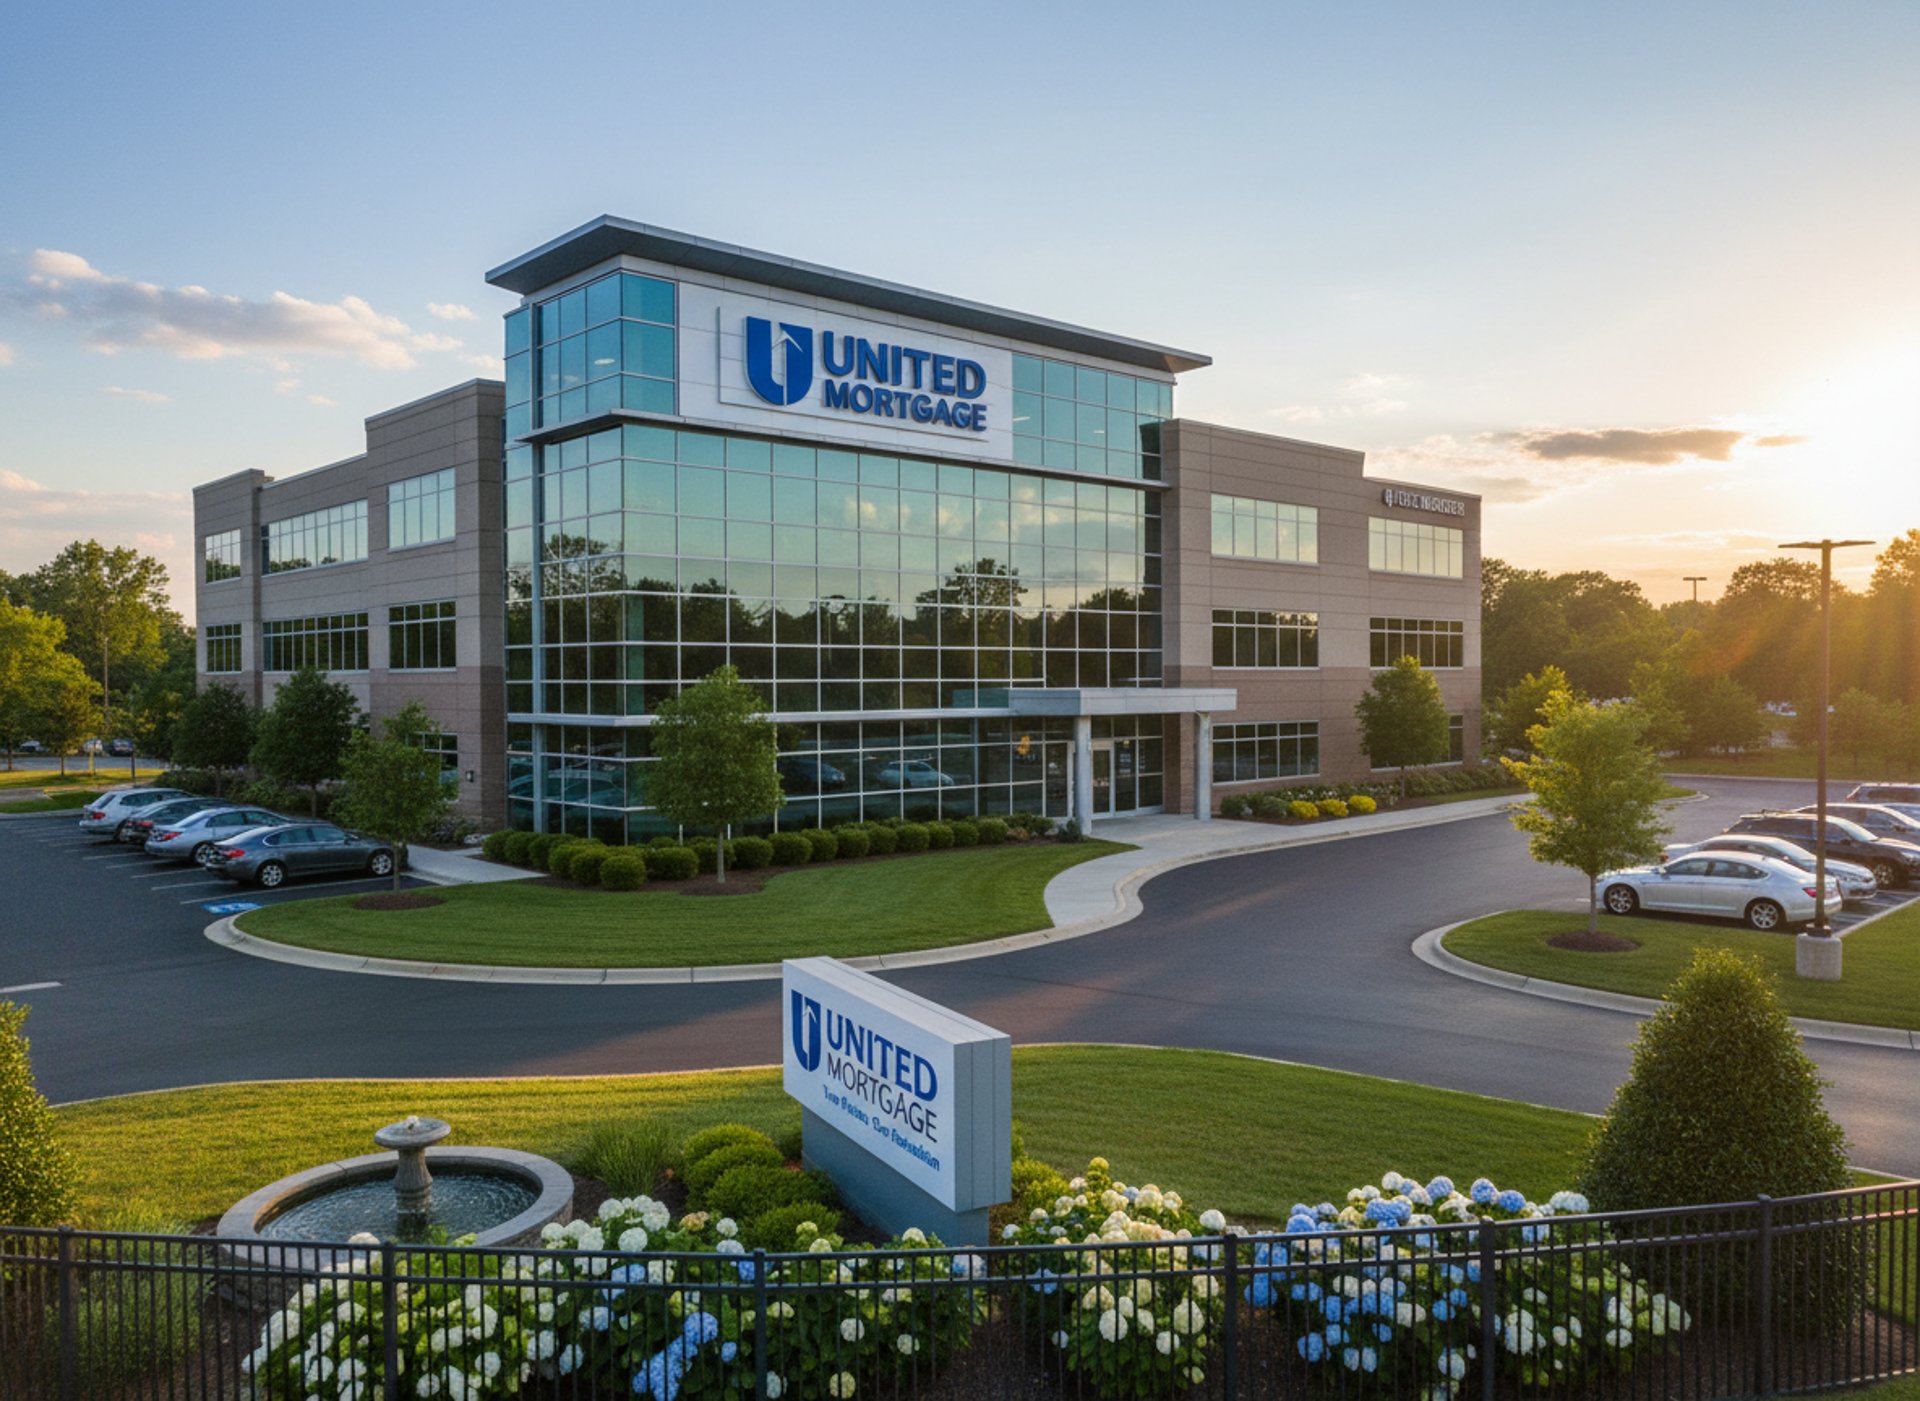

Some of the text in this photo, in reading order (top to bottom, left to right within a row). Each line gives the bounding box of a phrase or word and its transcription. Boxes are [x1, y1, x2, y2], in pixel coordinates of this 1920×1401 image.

[822, 330, 987, 400] UNITED
[824, 379, 987, 432] MORTGAGE
[827, 1009, 938, 1102] UNITED
[828, 1053, 937, 1143] MORTGAGE
